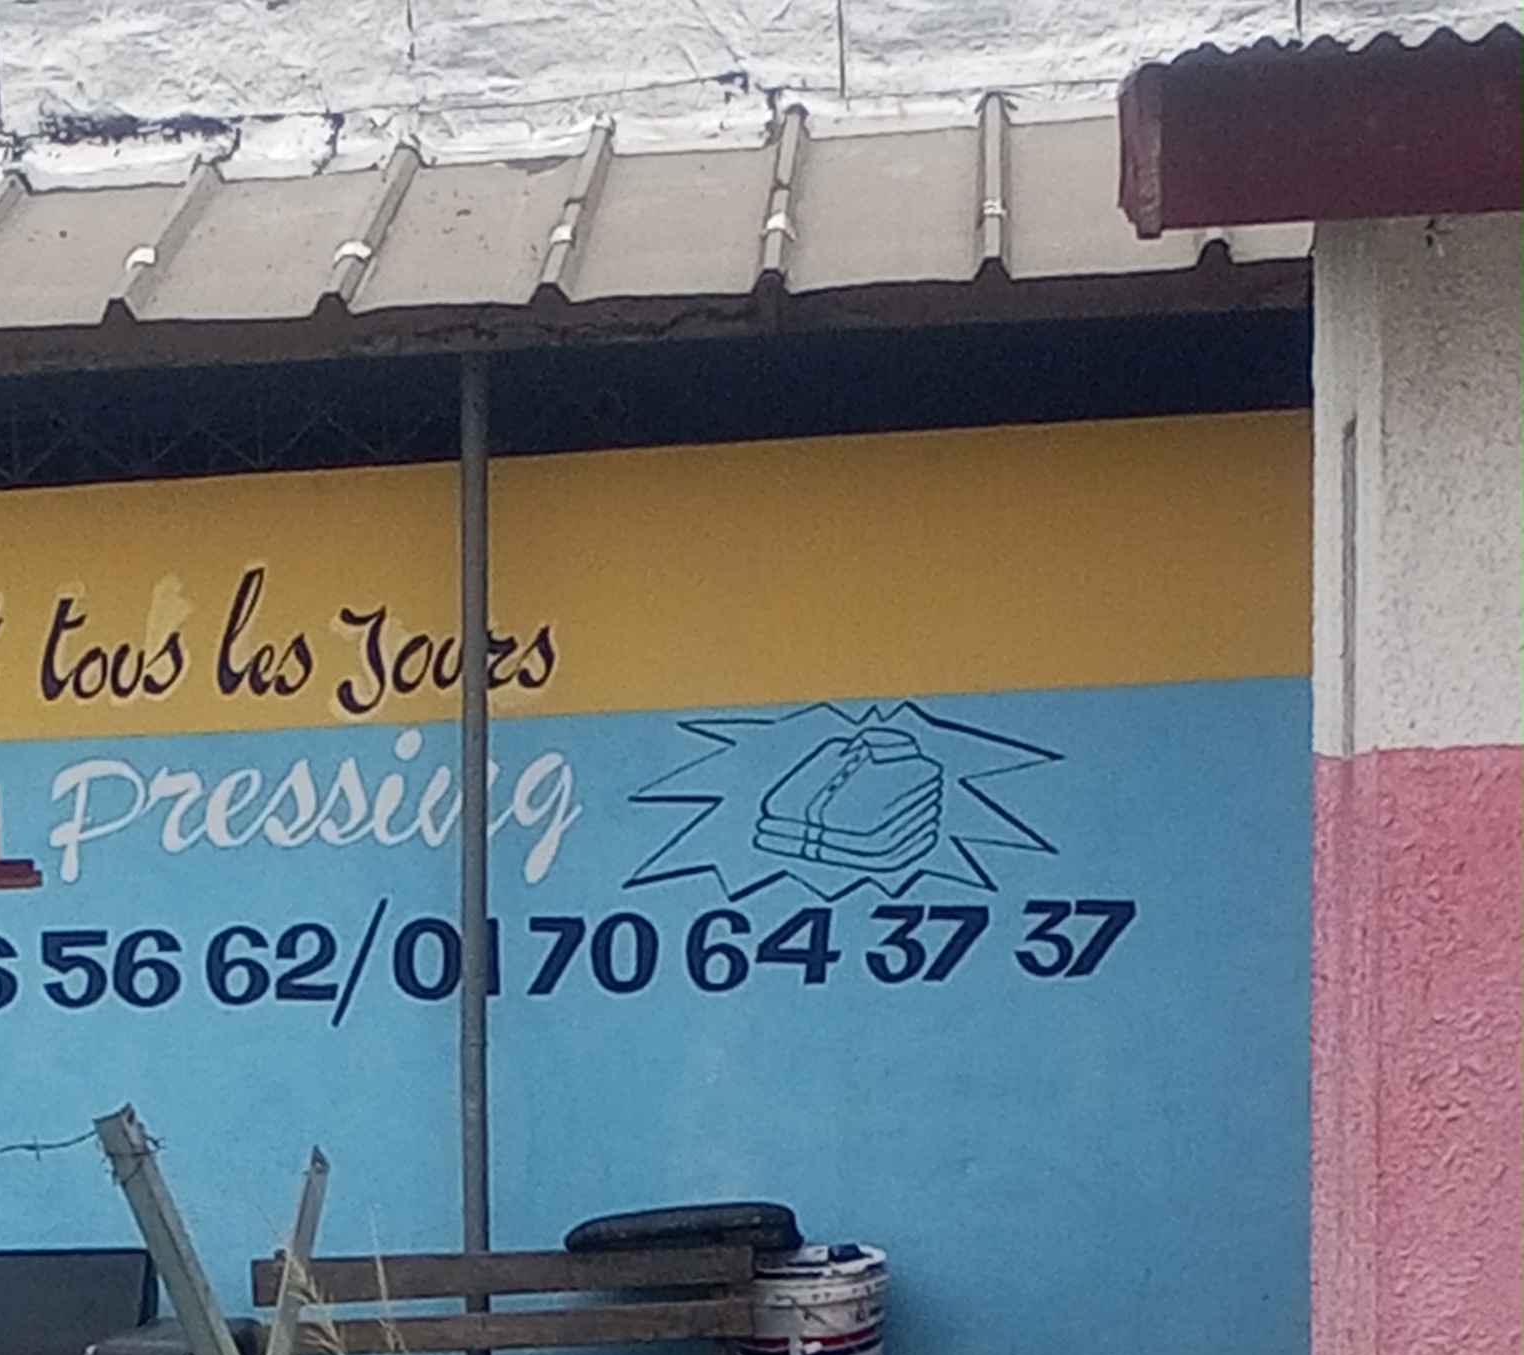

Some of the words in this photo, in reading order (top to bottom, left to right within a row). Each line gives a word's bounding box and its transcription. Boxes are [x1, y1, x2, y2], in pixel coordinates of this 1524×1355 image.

[40, 595, 183, 702] tous
[217, 566, 313, 697] les
[337, 605, 555, 716] Jours
[49, 728, 582, 885] Pressing
[40, 927, 182, 1009] 56
[526, 911, 659, 996] 70
[684, 908, 841, 991] 64
[865, 905, 989, 982] 37
[1015, 900, 1135, 977] 37
